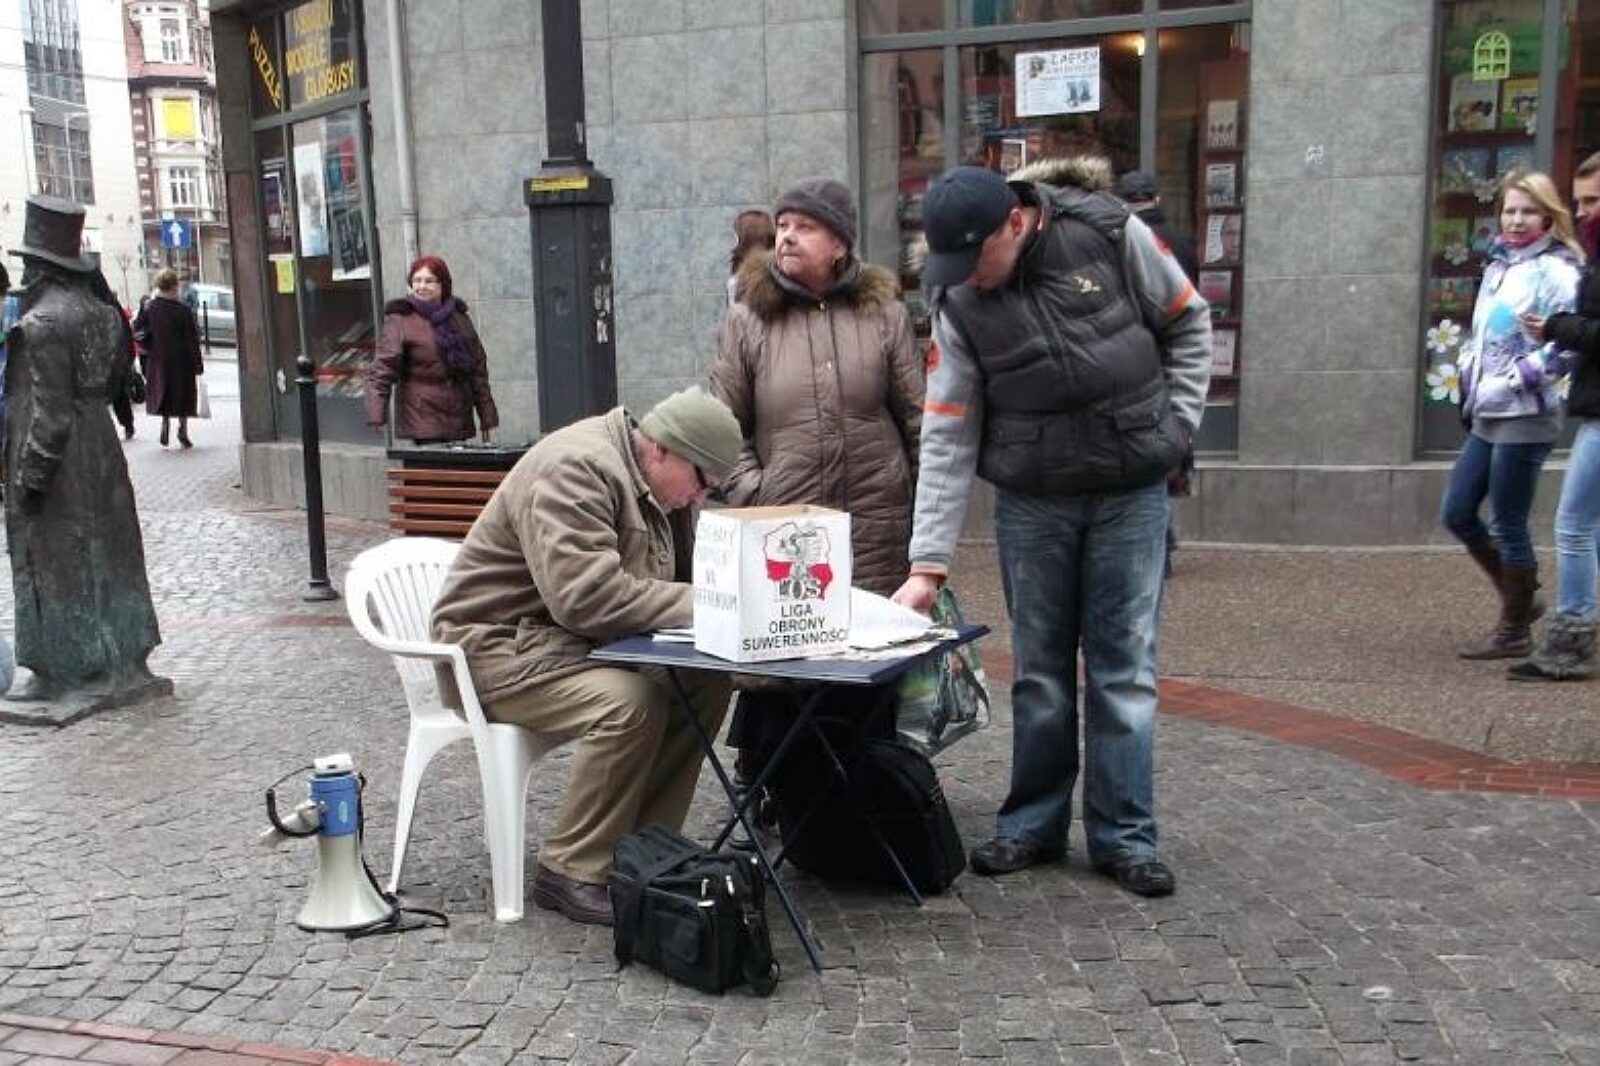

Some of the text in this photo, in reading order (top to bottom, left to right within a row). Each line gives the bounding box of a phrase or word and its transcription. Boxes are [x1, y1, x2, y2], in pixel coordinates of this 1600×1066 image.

[304, 58, 354, 102] GLOBUSY
[781, 604, 813, 618] LIGA
[769, 617, 825, 634] OBRONY
